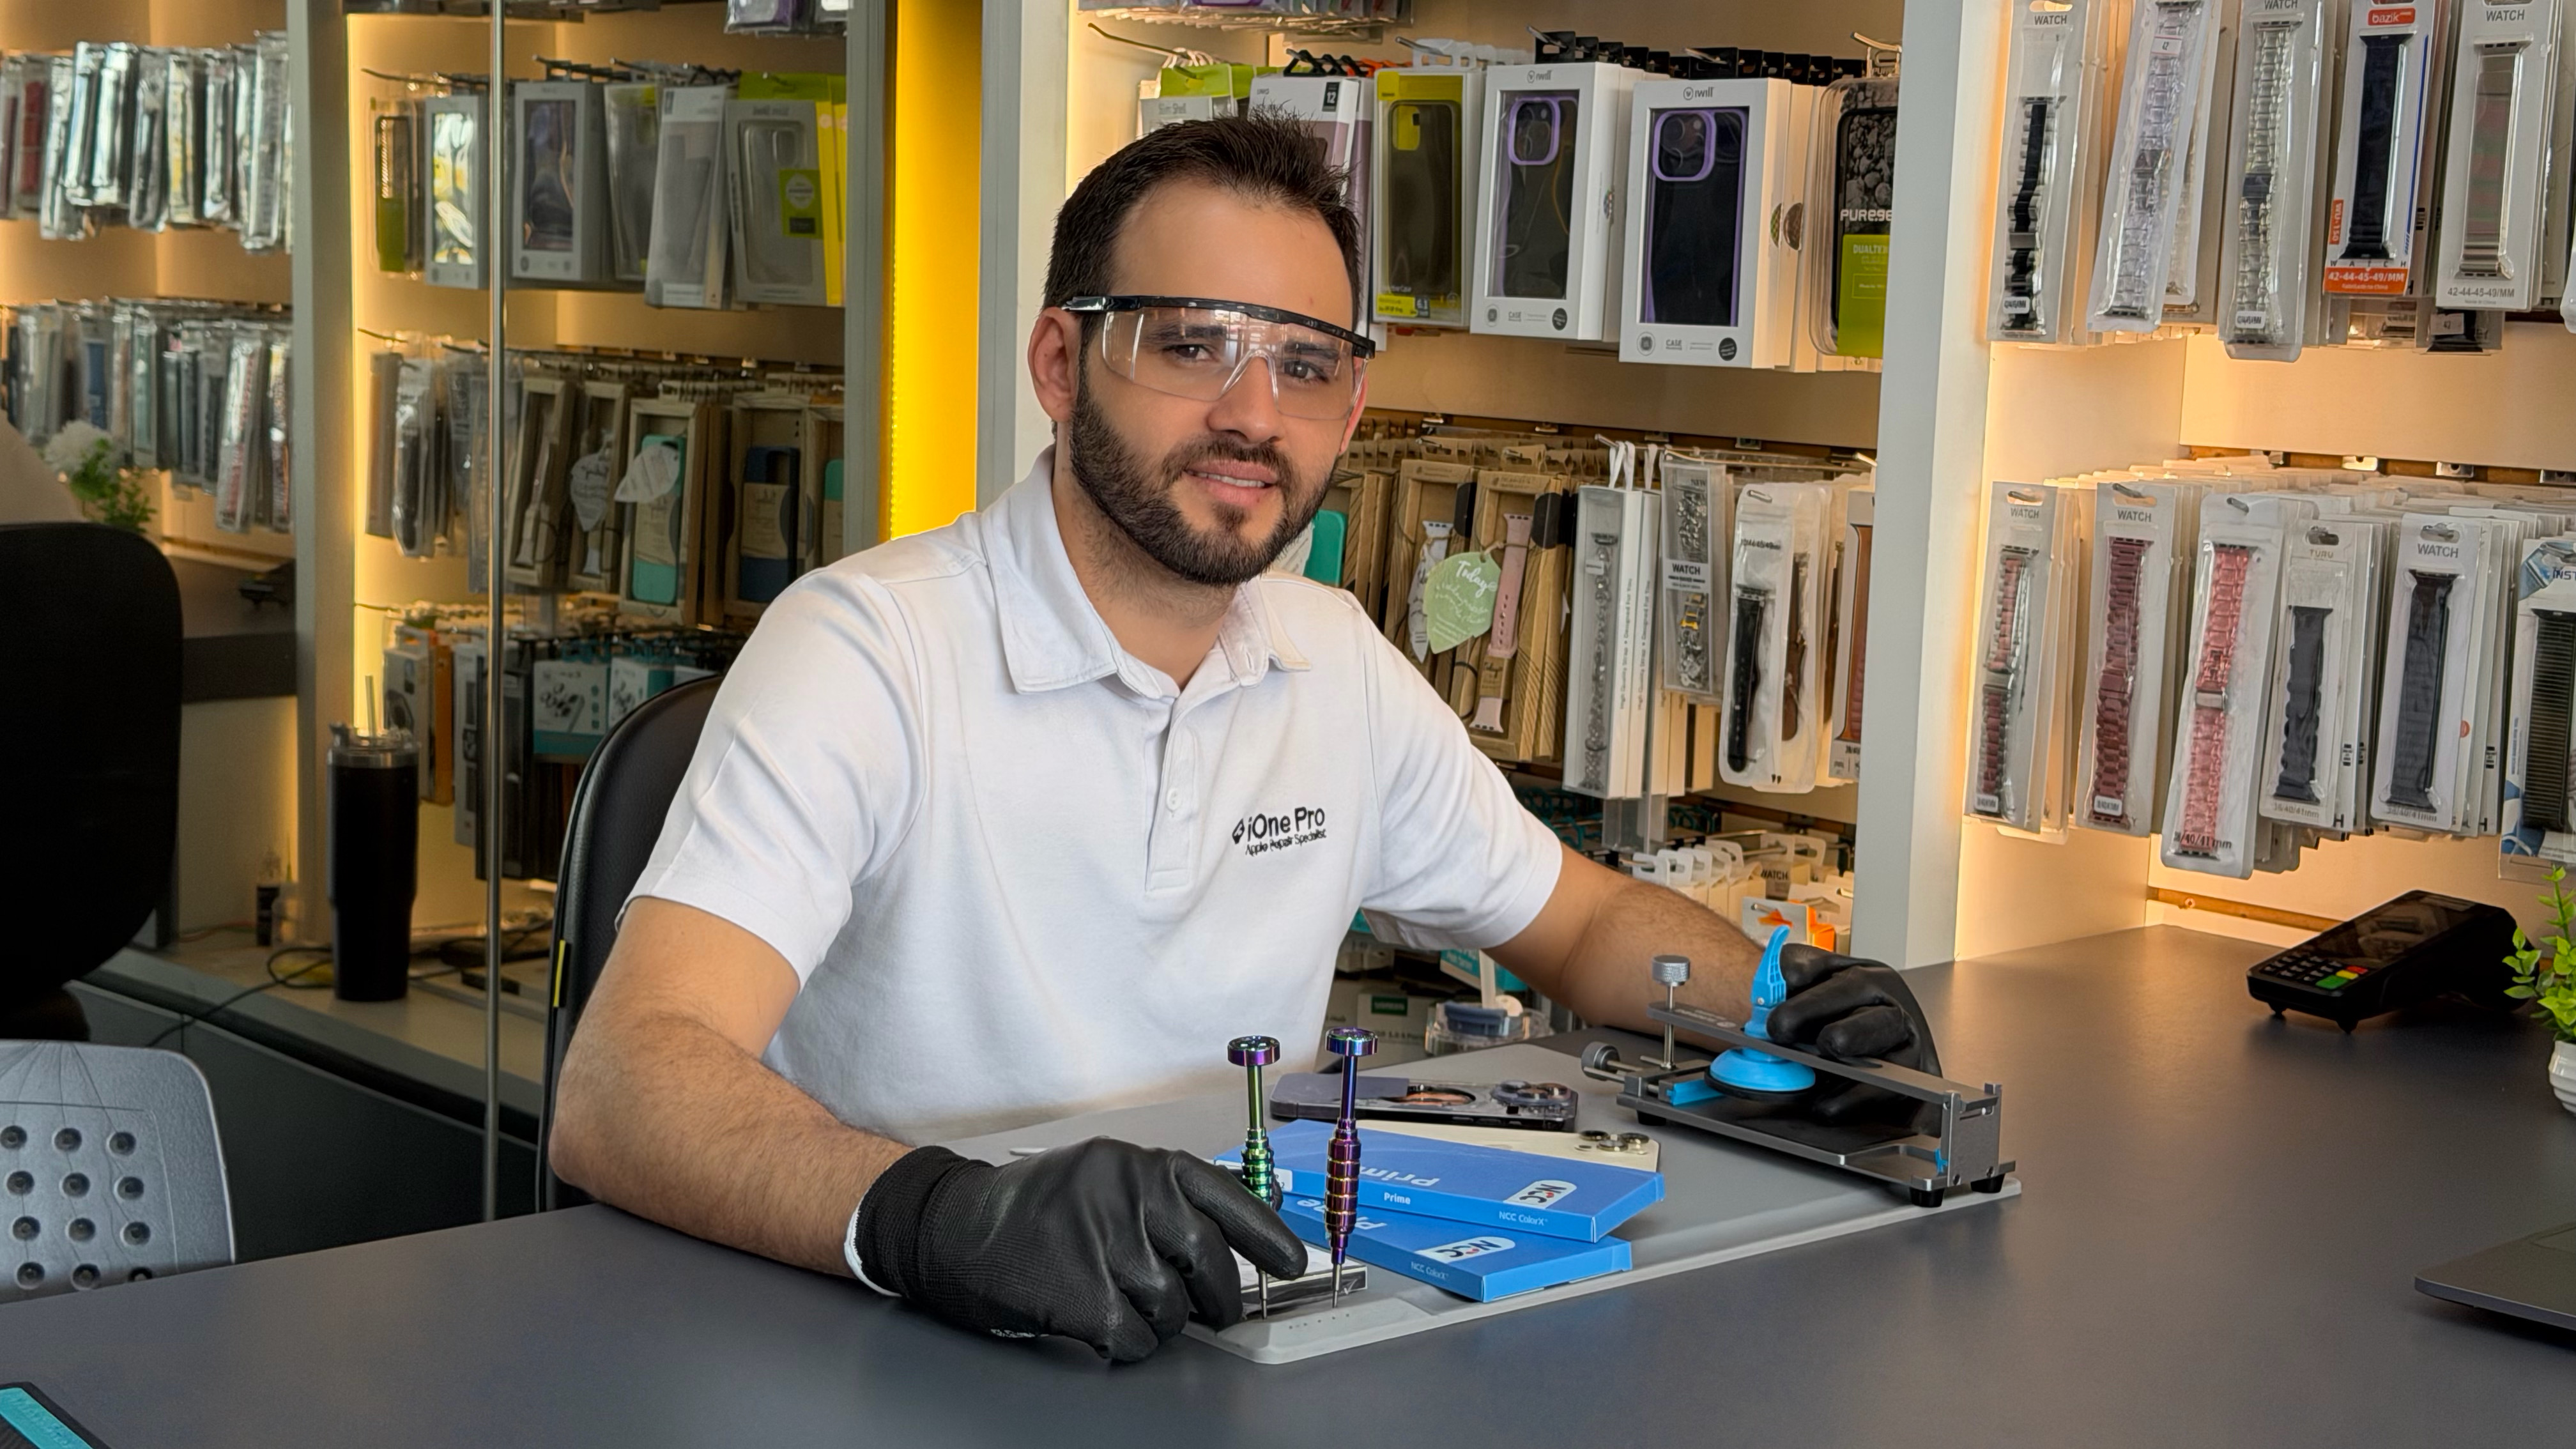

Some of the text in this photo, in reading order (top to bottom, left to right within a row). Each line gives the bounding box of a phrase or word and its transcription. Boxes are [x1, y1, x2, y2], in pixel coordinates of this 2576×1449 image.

[2264, 0, 2298, 10] WATCH
[2034, 15, 2067, 26] WATCH
[2372, 12, 2400, 24] bazik
[2486, 10, 2524, 22] WATCH
[1327, 91, 1337, 103] 12
[2328, 272, 2405, 282] 42-44-45-49/MM
[2448, 287, 2515, 298] 42-44-45-49/MM
[2010, 507, 2039, 519] WATCH
[2117, 509, 2152, 522] WATCH
[2417, 543, 2459, 558] WATCH
[1673, 563, 1701, 575] WATCH
[1248, 806, 1325, 841] iOne Pro
[1245, 841, 1268, 857] Apple
[1361, 1166, 1439, 1187] Prim
[1384, 1192, 1411, 1205] Prime
[1499, 1211, 1516, 1222] NCC
[1411, 1261, 1425, 1274] NCC
